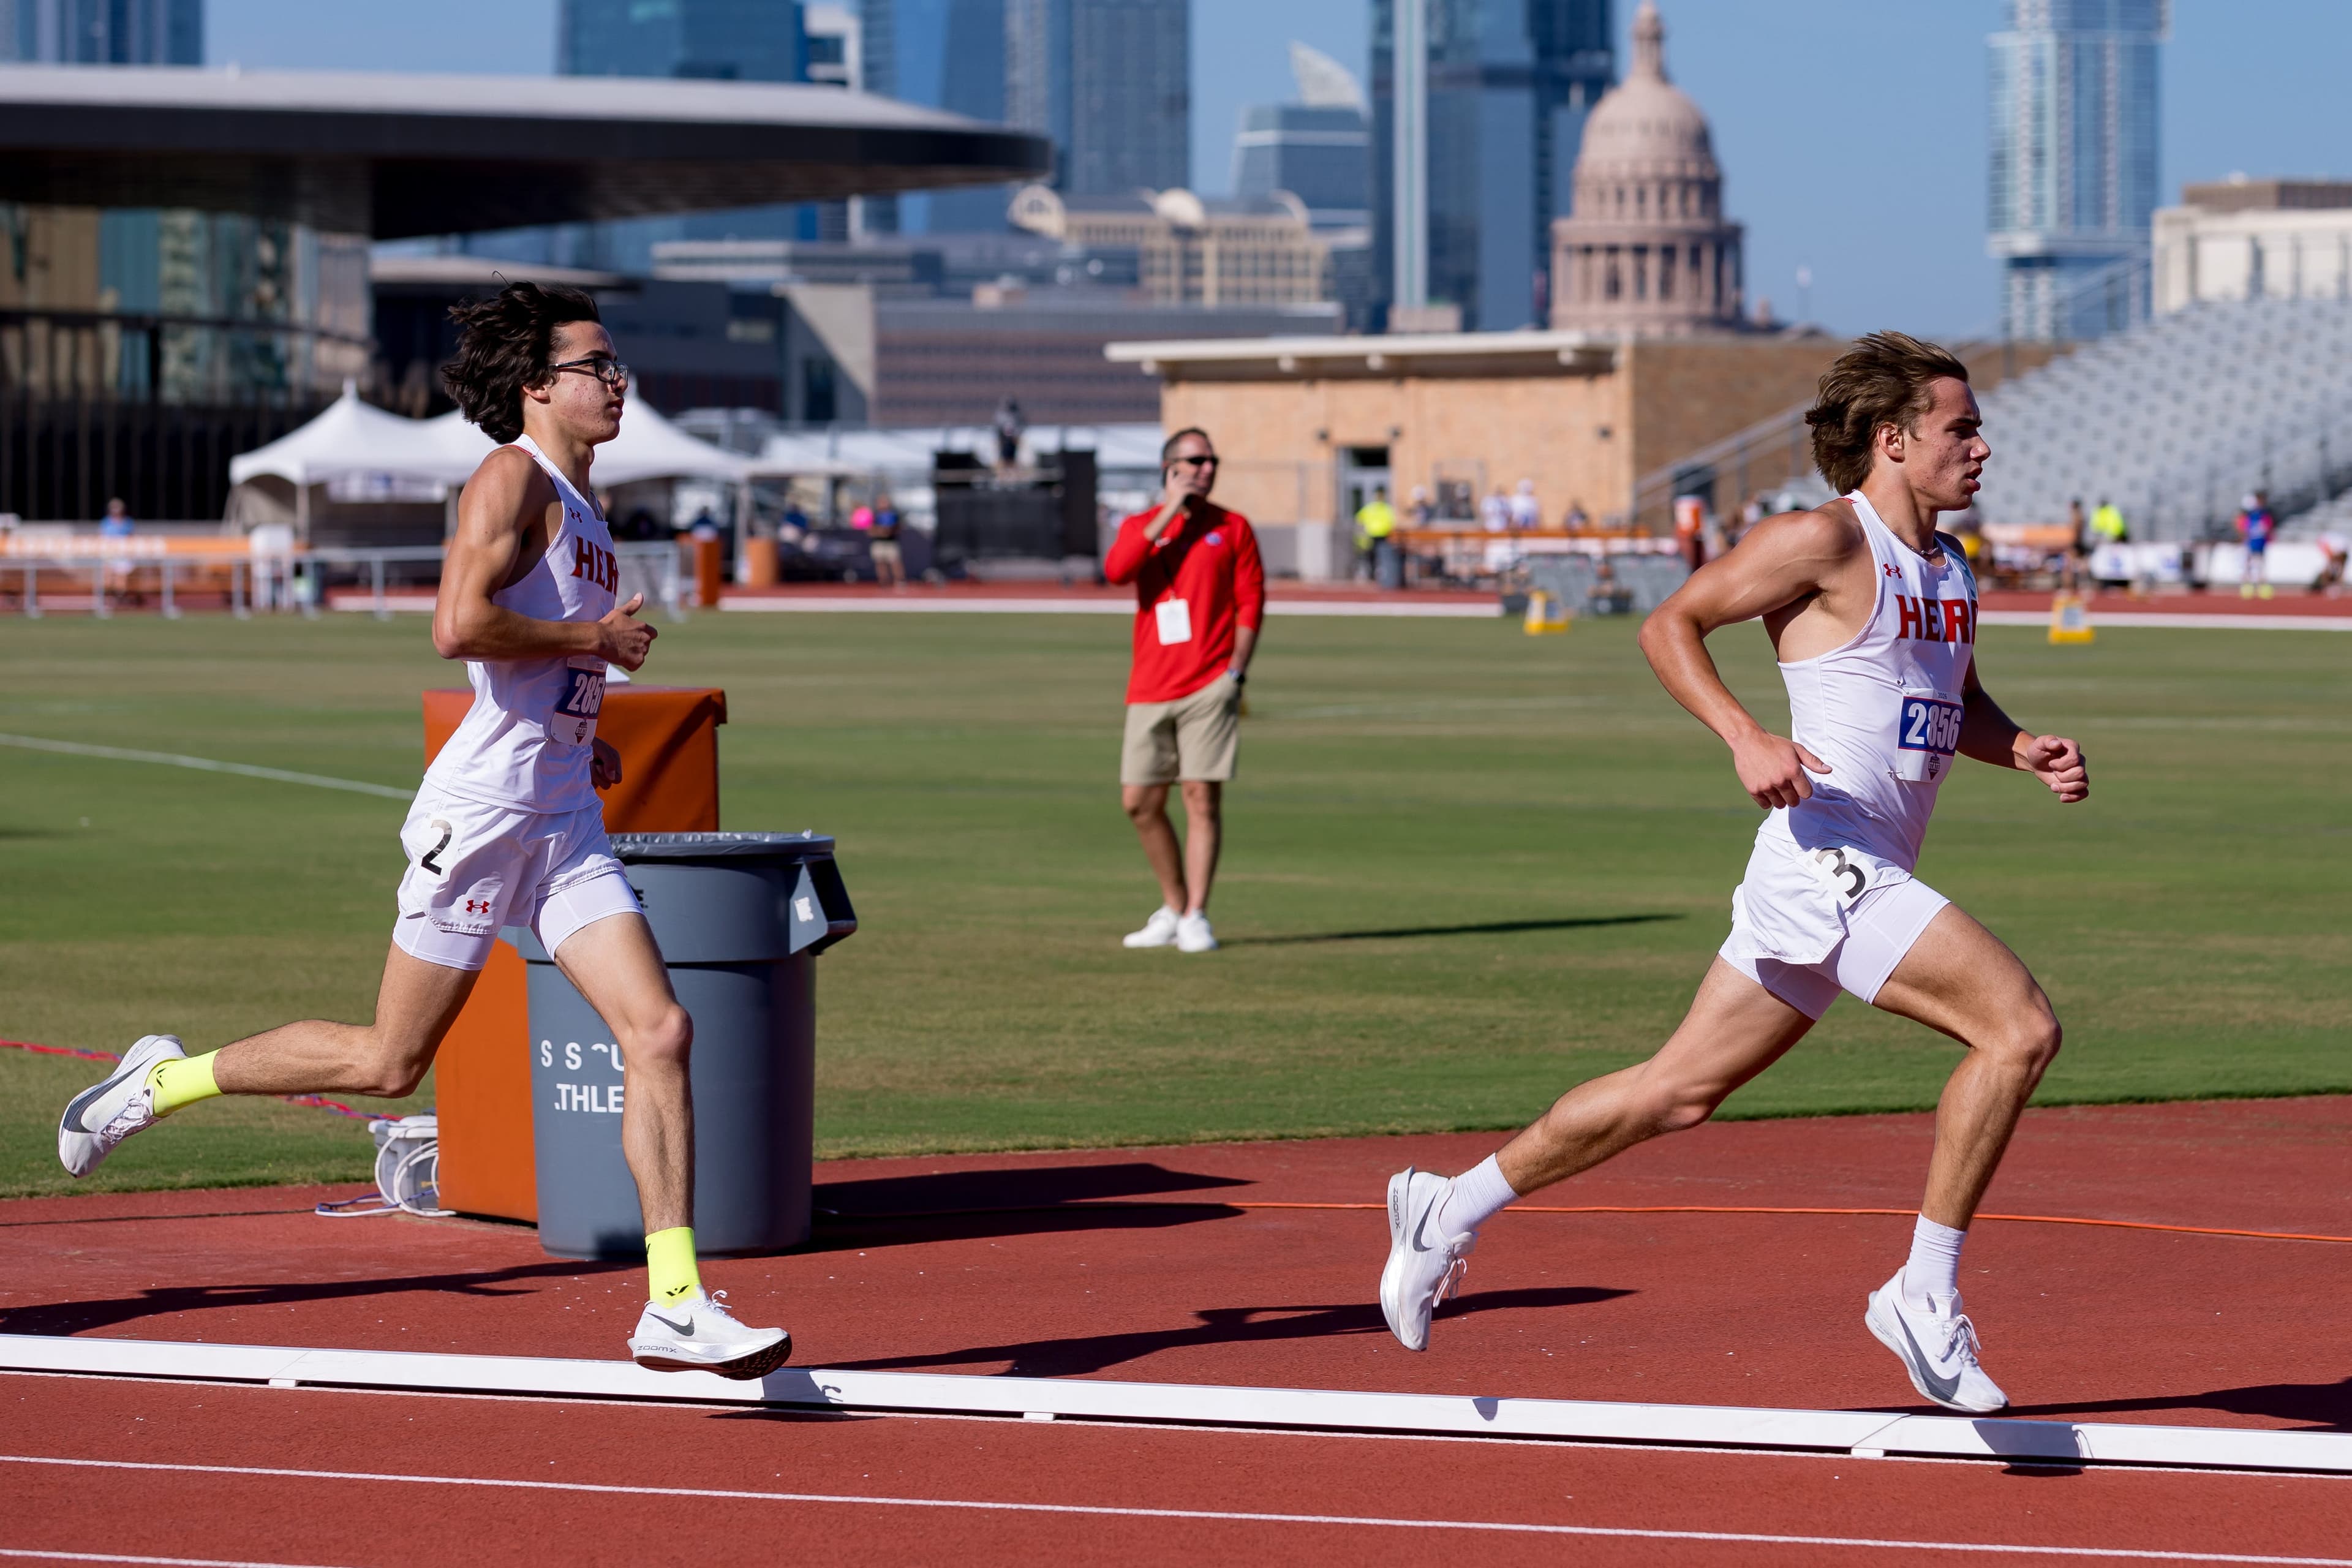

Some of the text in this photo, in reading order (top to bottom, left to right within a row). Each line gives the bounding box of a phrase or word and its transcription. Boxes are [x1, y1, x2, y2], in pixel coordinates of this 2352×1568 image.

[1905, 703, 1961, 750] 2856
[1928, 761, 1940, 770] STATE
[421, 820, 453, 876] 2
[1815, 847, 1866, 899] 3
[554, 1084, 625, 1113] THLE
